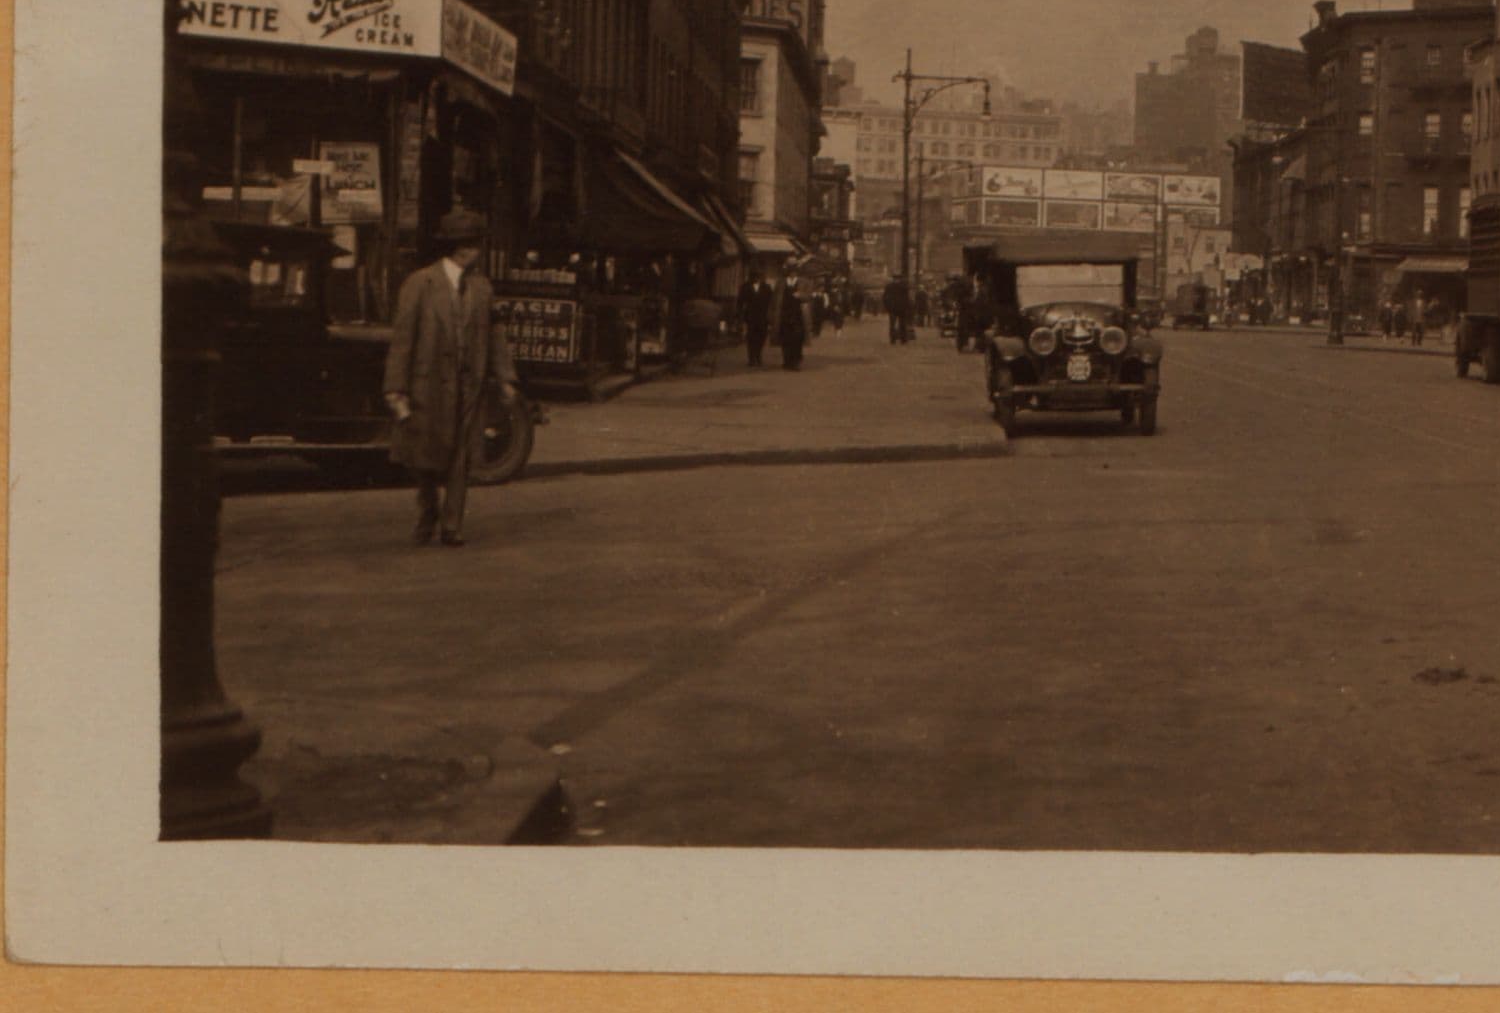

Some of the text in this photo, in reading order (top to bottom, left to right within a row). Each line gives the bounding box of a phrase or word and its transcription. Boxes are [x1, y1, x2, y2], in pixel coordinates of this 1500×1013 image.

[186, 0, 279, 32] NETTE
[373, 13, 401, 29] ICE
[355, 28, 414, 46] CREAM
